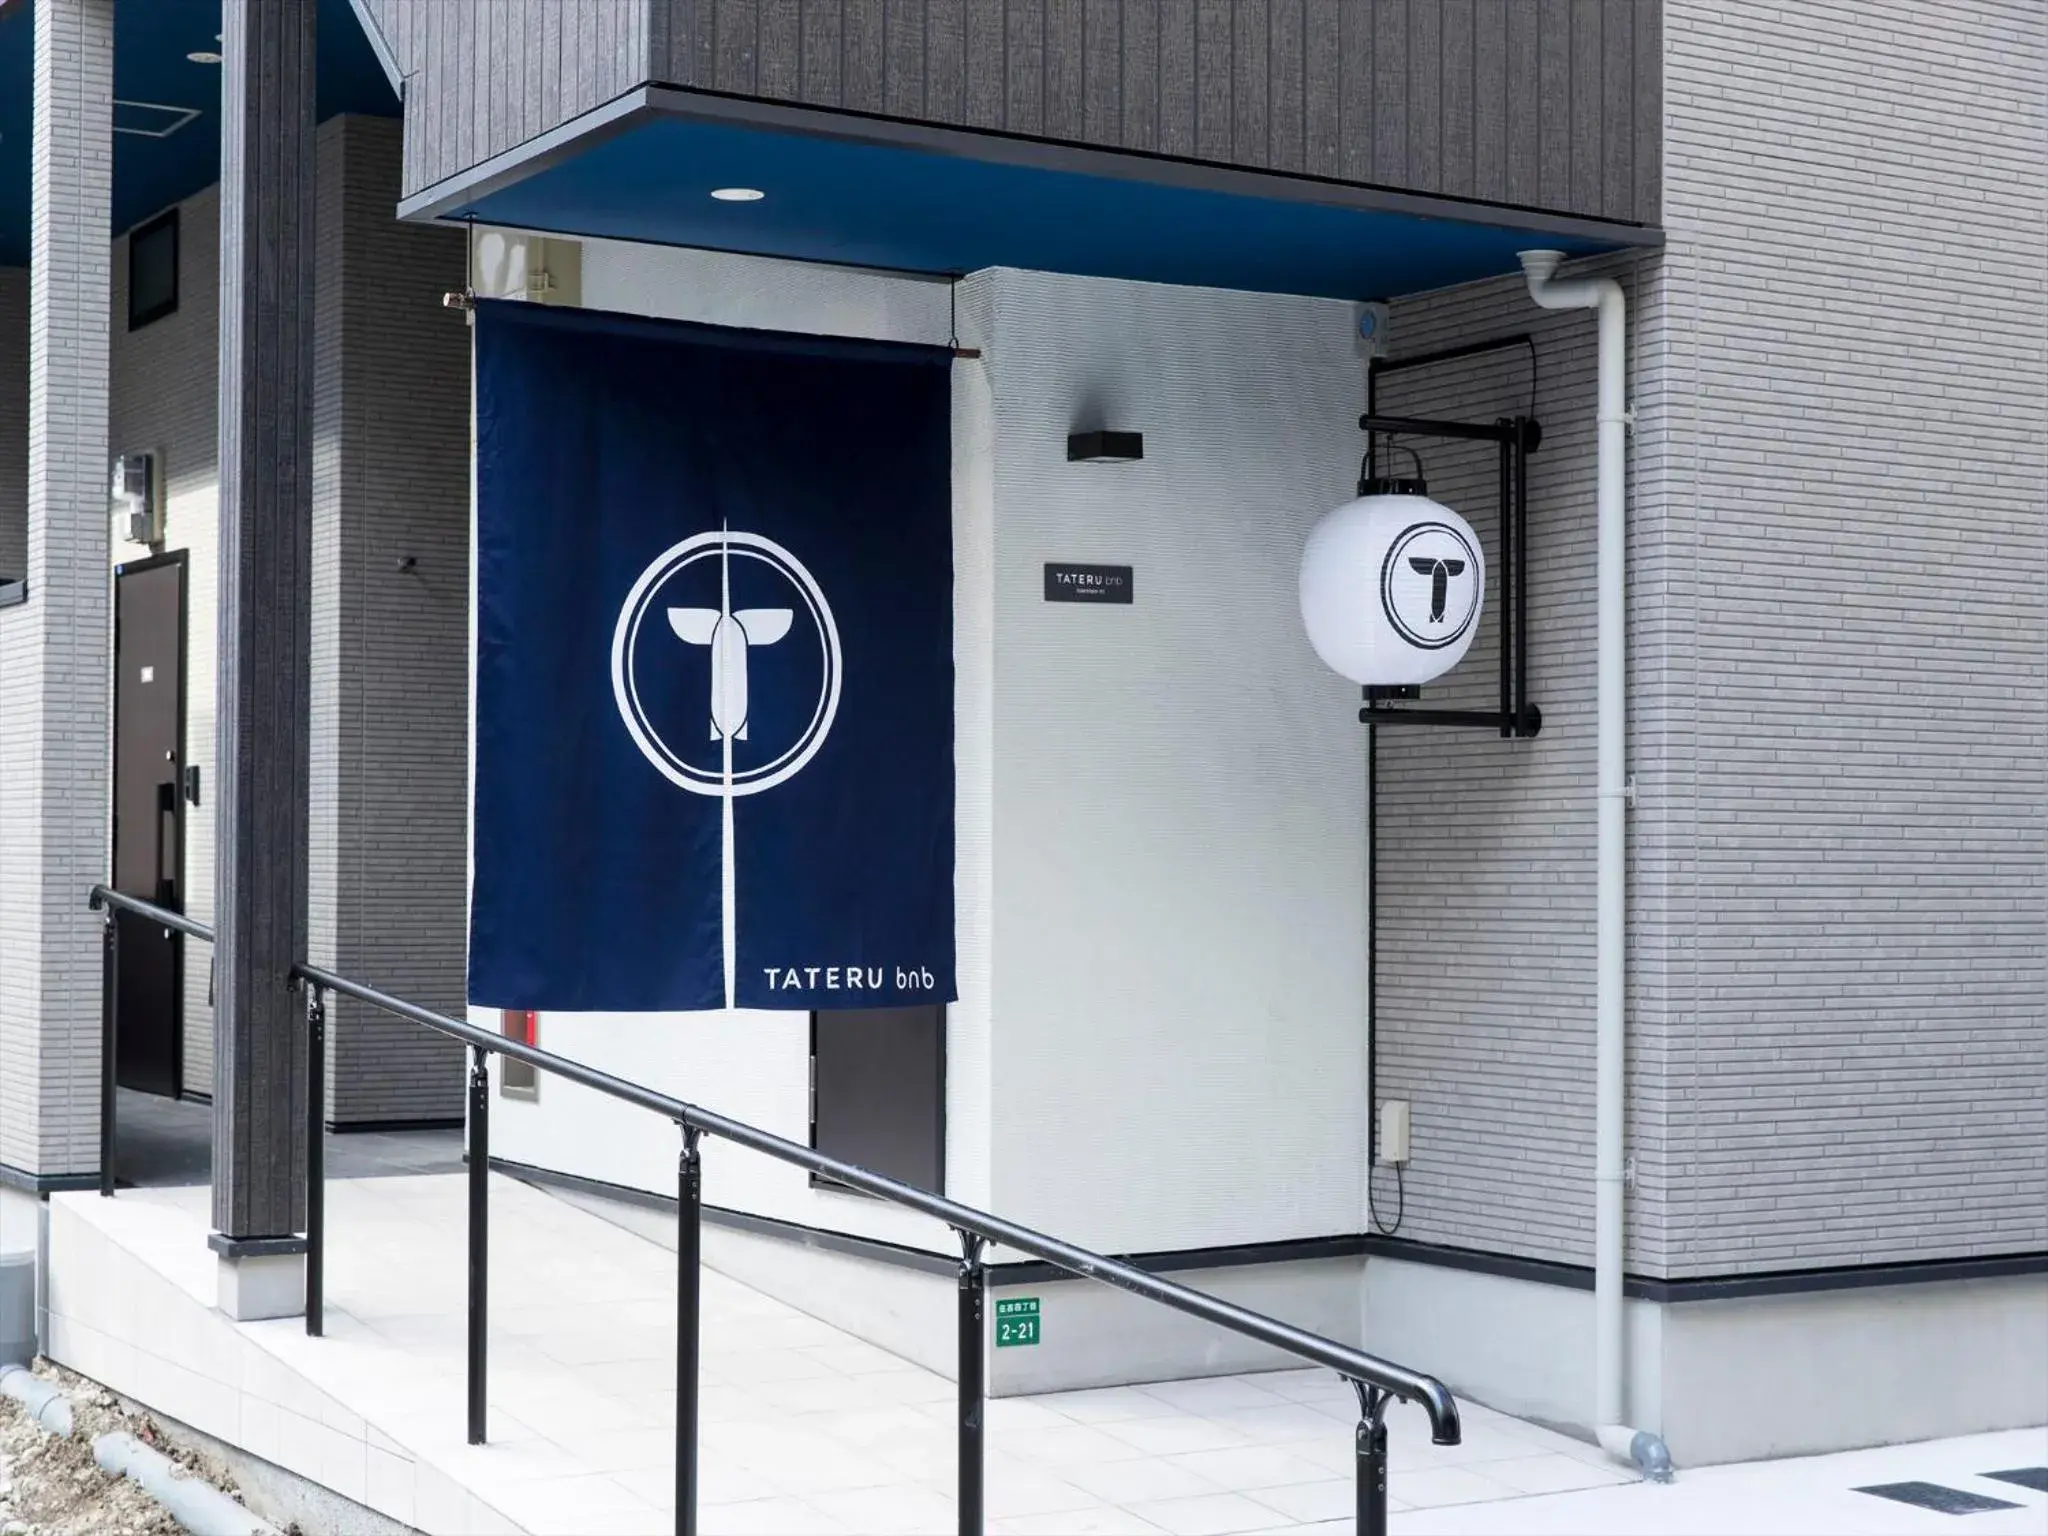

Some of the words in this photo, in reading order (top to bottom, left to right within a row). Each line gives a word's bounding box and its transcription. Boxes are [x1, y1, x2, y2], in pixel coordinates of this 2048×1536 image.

[1056, 573, 1103, 586] TATERU
[764, 967, 883, 990] TATERU
[896, 966, 935, 990] bnb
[1002, 1321, 1034, 1340] 2-21
